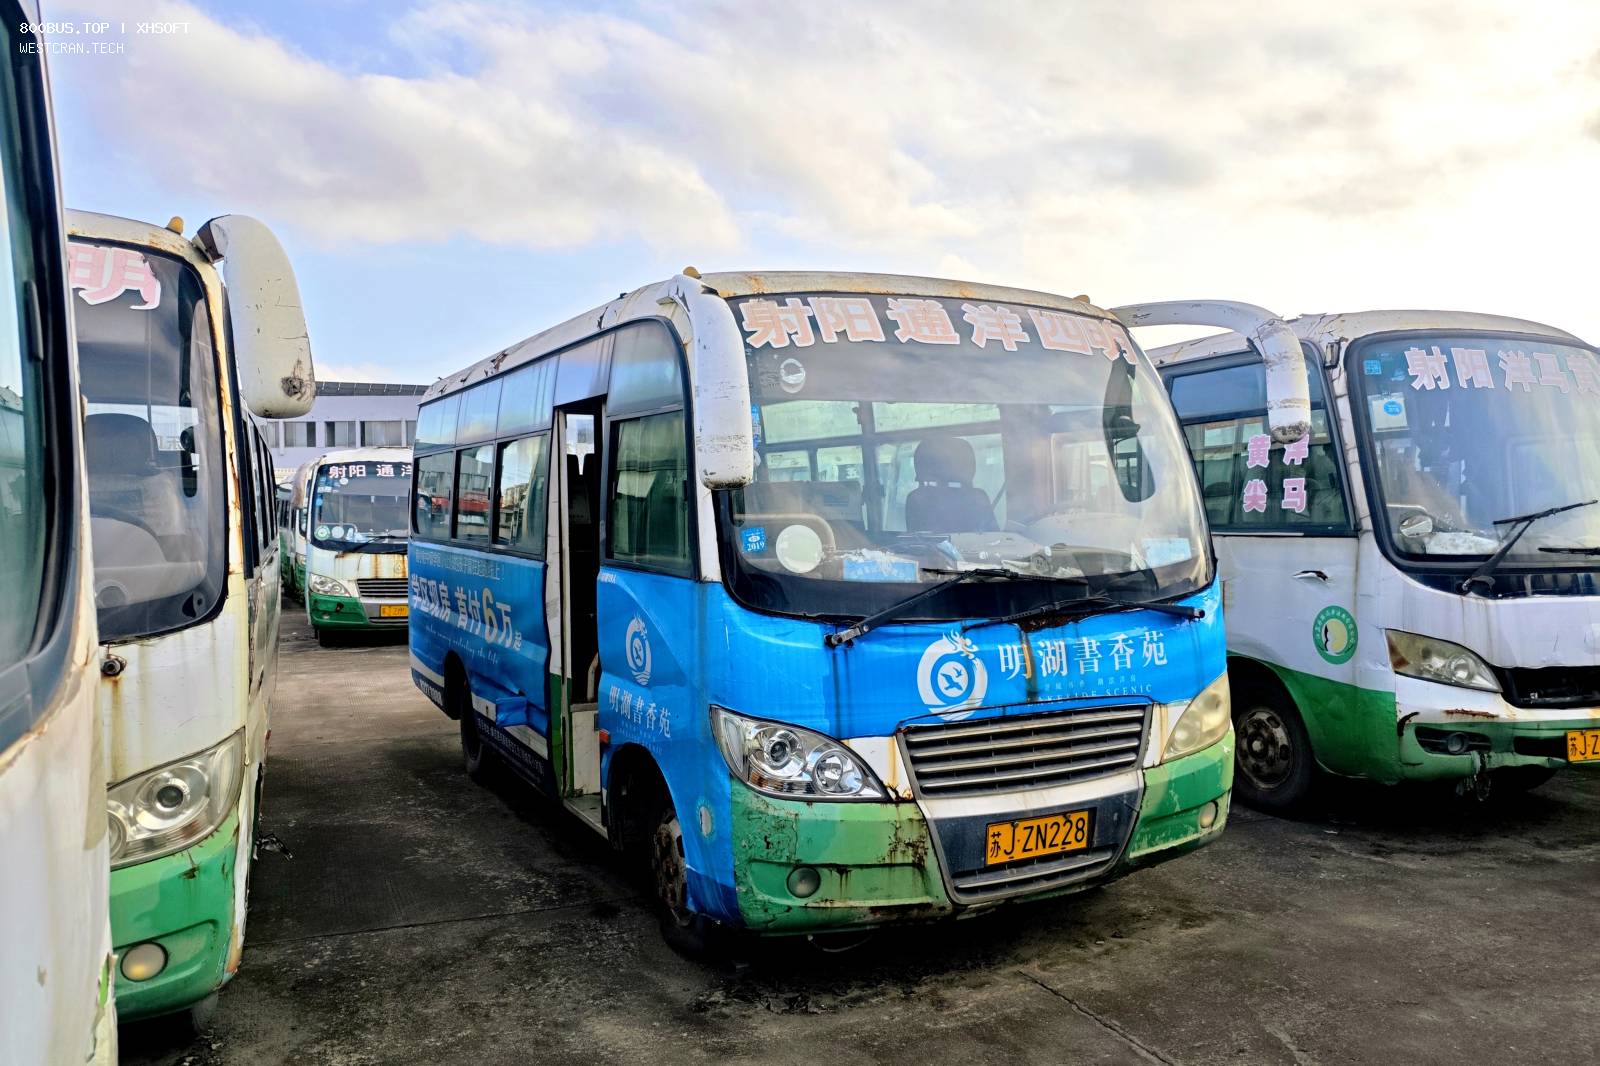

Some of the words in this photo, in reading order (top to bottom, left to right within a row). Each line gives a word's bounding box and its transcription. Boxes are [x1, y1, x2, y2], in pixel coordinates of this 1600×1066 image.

[997, 630, 1168, 681] 明湖書香苑
[1105, 683, 1152, 697] SCENIC
